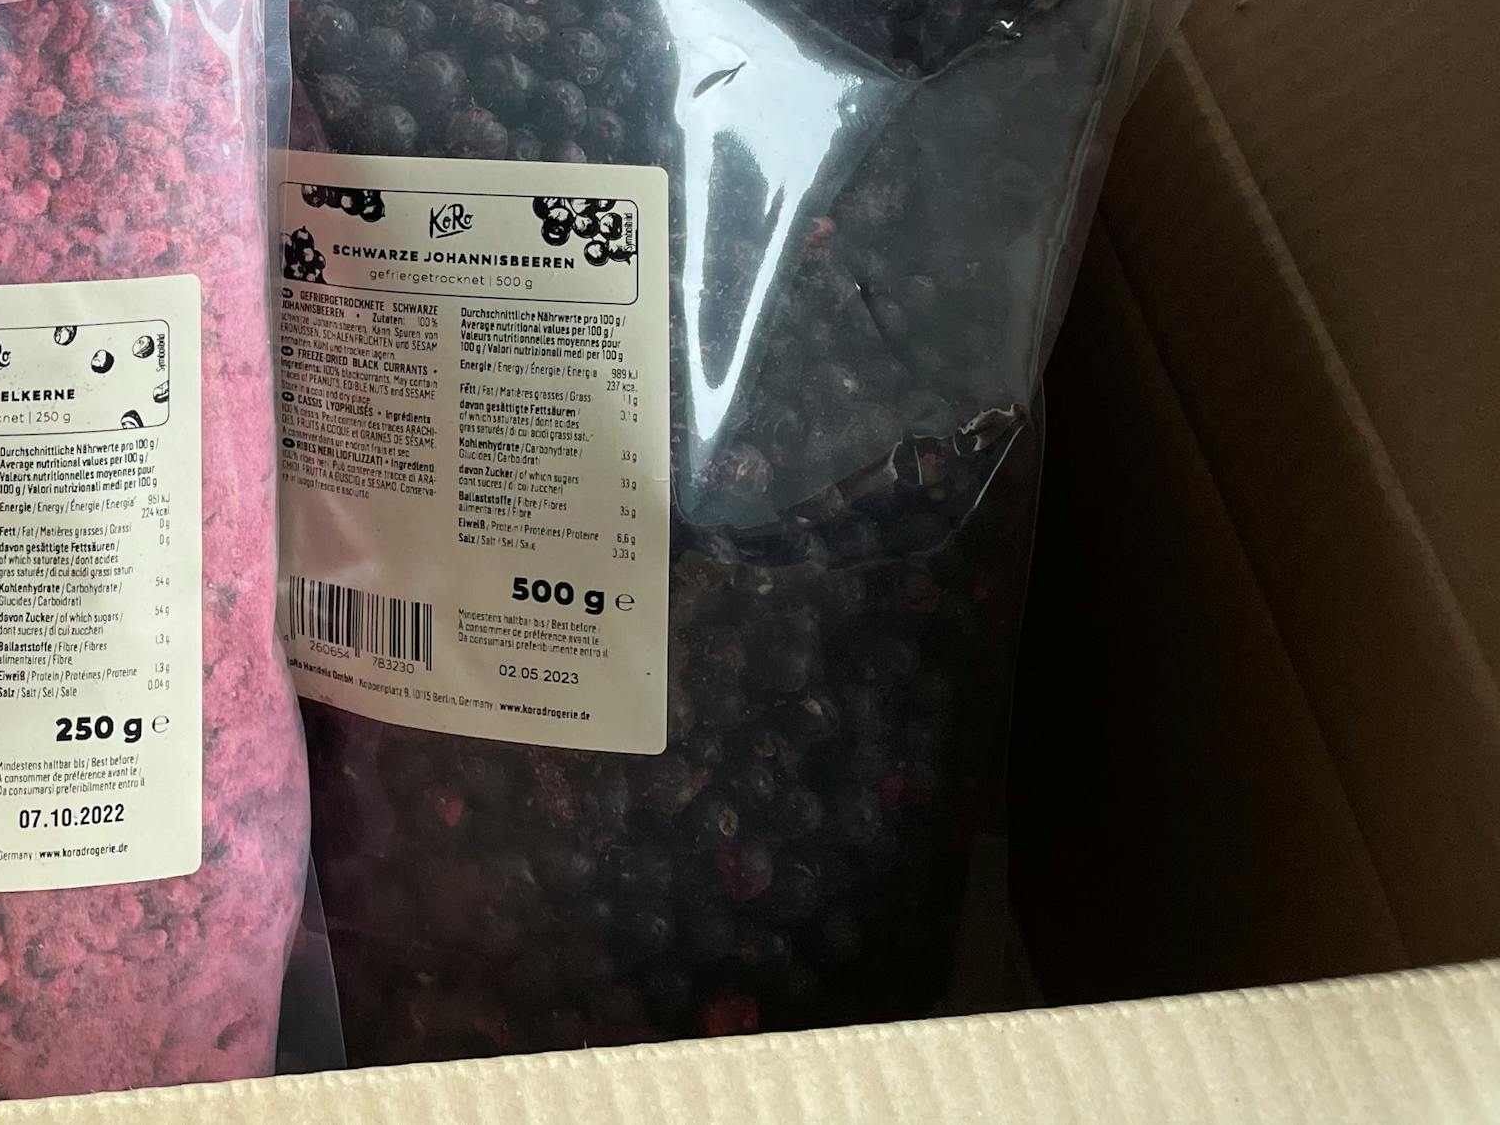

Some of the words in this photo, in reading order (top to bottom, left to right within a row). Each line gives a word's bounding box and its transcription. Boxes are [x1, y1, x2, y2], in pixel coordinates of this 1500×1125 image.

[428, 203, 473, 239] KoRo
[333, 244, 418, 262] SCHWARZE
[424, 251, 575, 269] JOHANNISBEEREN
[370, 268, 485, 287] gefriergetrocknet
[496, 276, 521, 288] 500
[524, 278, 533, 290] g
[282, 299, 344, 318] JOHANNISBEEREN
[300, 291, 385, 311] GEFRIERGETROCKNETE
[393, 302, 438, 315] SCHWARZE
[461, 307, 535, 320] Durchschnittliche
[537, 311, 581, 323] Nährwerte
[584, 316, 598, 325] pro
[600, 314, 614, 324] 100
[616, 318, 620, 326] g
[461, 319, 494, 330] Average
[496, 323, 541, 333] nutritional
[543, 325, 570, 334] values
[572, 326, 586, 336] per
[588, 326, 601, 336] 100
[604, 329, 608, 338] g
[461, 330, 491, 341] Valeurs
[493, 334, 555, 345] nutritionnelles
[557, 338, 599, 348] moyennes
[602, 340, 620, 349] pour
[298, 349, 348, 366] FREEZE-DRIED
[352, 357, 378, 370] BLACK
[384, 362, 428, 375] CURRANTS
[298, 395, 322, 408] CASSIS
[326, 401, 373, 417] LYOPHILISÉS
[36, 412, 59, 422] 250
[63, 414, 71, 427] g
[0, 445, 74, 457] Durchschnittliche
[76, 442, 119, 454] Nährwerte
[121, 442, 133, 452] pro
[136, 439, 148, 449] 100
[150, 439, 154, 450] g
[0, 459, 34, 470] Average
[36, 458, 80, 468] nutritional
[82, 455, 108, 466] values
[110, 454, 122, 465] per
[124, 453, 138, 463] 100
[139, 454, 144, 463] g
[0, 472, 31, 482] Valeurs
[32, 470, 94, 481] nutritionnelles
[96, 467, 135, 479] moyennes
[138, 465, 154, 476] pour
[0, 484, 13, 494] 100
[16, 486, 20, 496] g
[28, 483, 52, 494] Valori
[54, 480, 100, 494] nutrizionali
[102, 480, 122, 491] medi
[124, 480, 136, 491] per
[138, 477, 151, 487] 100
[152, 477, 157, 487] g
[0, 501, 32, 513] Energie
[38, 501, 63, 514] Energy
[70, 498, 100, 513] Énergie
[0, 583, 60, 594] Kohlenhydrate
[66, 583, 118, 595] Carbohydrate
[512, 577, 574, 606] 500
[584, 589, 605, 615] g
[0, 614, 23, 623] davon
[26, 613, 53, 623] Zucker
[0, 643, 52, 652] Ballaststoffe
[309, 640, 350, 660] 260654
[372, 656, 414, 674] 783230
[500, 702, 591, 721] www.korodrogerie.de
[56, 716, 114, 742] 250
[124, 717, 142, 743] g
[44, 759, 71, 769] haltbar
[74, 759, 85, 769] bis
[92, 757, 108, 767] Best
[110, 755, 134, 766] before
[5, 774, 50, 783] consommer
[53, 773, 61, 781] de
[64, 770, 106, 782] préférence
[108, 768, 128, 778] avant
[9, 784, 54, 795] consumarsi
[56, 780, 116, 795] preferibilmente
[118, 779, 138, 789] entro
[141, 778, 145, 787] il
[20, 804, 124, 828] 07.10.2022
[39, 843, 128, 859] www.korodrogerie.de
